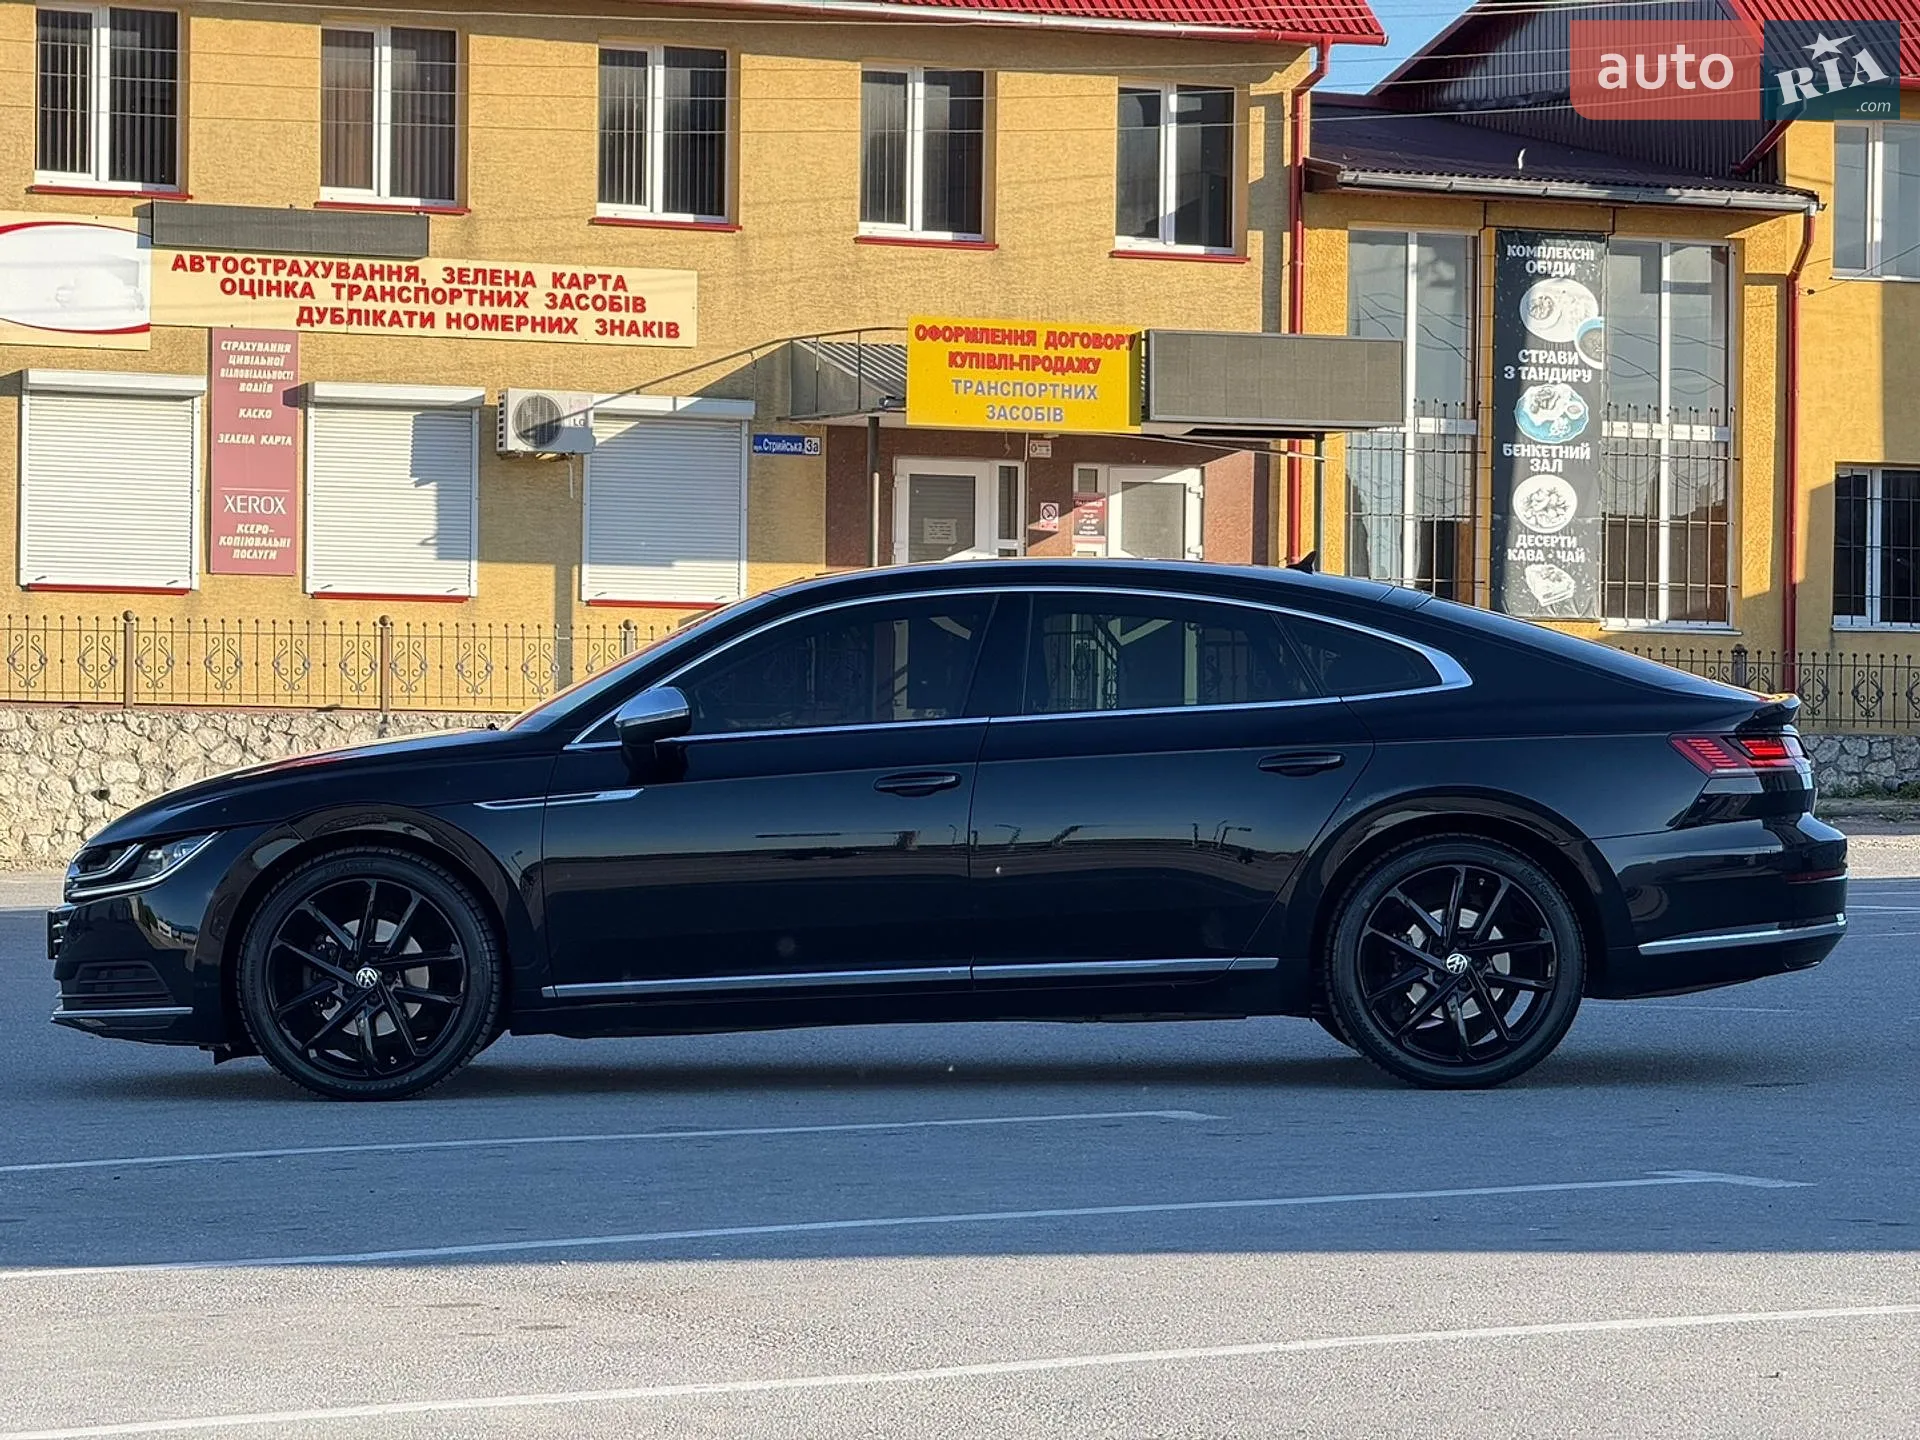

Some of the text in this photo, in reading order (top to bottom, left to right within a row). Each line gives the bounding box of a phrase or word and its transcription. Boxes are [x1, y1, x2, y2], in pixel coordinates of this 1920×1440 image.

[1507, 245, 1595, 261] КОМПЛЕКСНІ
[171, 254, 628, 293] АВТОСТРАХУВАННЯ, ЗЕЛЕНА КАРТА
[1525, 260, 1576, 277] ОБІДИ
[220, 278, 647, 313] ОЦІНКА ТРАНСПОРТНИХ ЗАСОБІВ
[296, 306, 681, 339] ДУБЛІКАТИ НОМЕРНИХ ЗНАКІВ
[914, 324, 1137, 352] ОФОРМЛЕННЯ ДОГОВОРУ
[221, 341, 292, 353] СТРАХУВАННЯ
[228, 354, 285, 366] ЦИВІЛЬНОЇ
[948, 351, 1101, 375] КУПІВЛІ-ПРОДАЖУ
[1518, 349, 1579, 364] СТРАВИ
[1504, 366, 1593, 384] З ТАНДИРУ
[951, 379, 1098, 400] ТРАНСПОРТНИХ
[239, 408, 273, 419] КАСКО
[986, 405, 1064, 423] ЗАСОБІВ
[218, 433, 292, 446] ЗЕЛЕНА КАРТА
[1502, 442, 1591, 460] БЕНКЕТНИЙ
[1529, 459, 1563, 472] ЗАЛ
[223, 494, 287, 515] XEROX
[1516, 534, 1577, 548] ДЕСЕРТИ
[232, 549, 278, 560] ПОСЛУГИ
[1507, 547, 1585, 563] КАВА ЧАЙ
